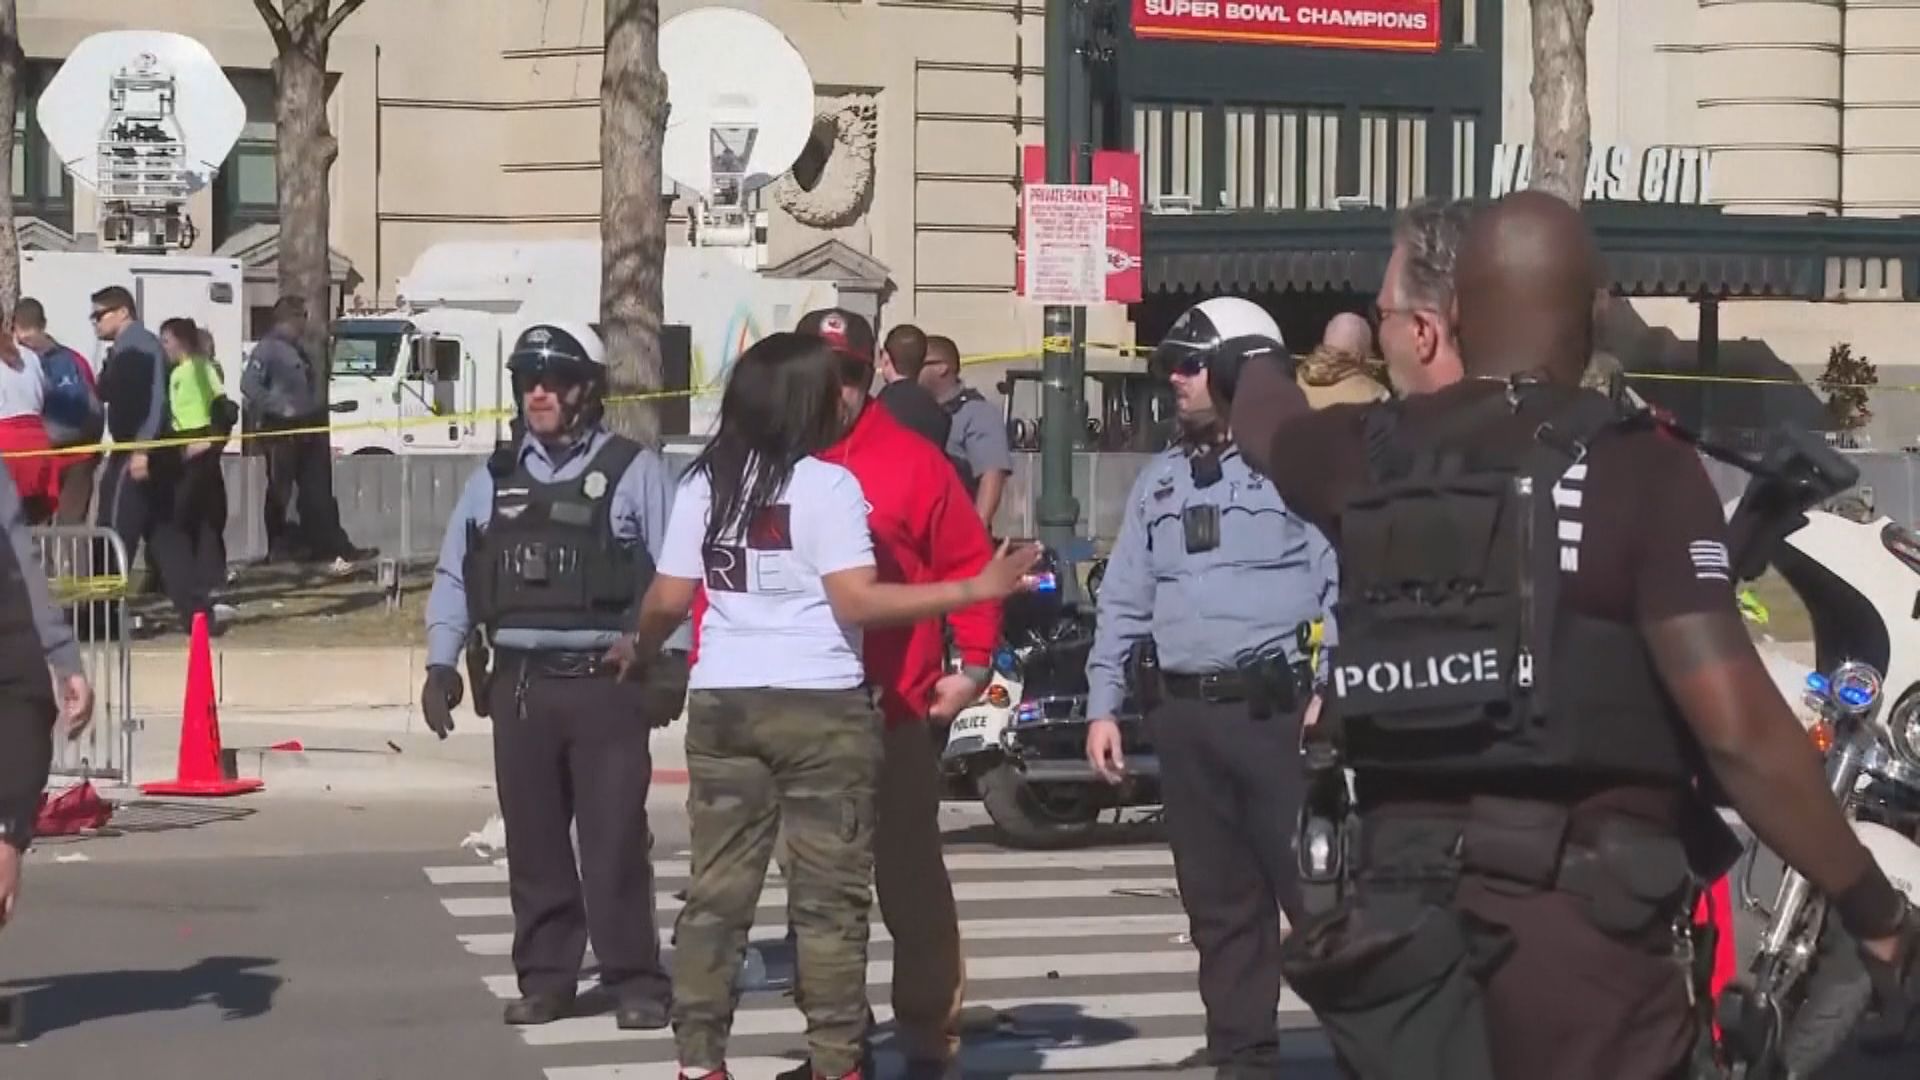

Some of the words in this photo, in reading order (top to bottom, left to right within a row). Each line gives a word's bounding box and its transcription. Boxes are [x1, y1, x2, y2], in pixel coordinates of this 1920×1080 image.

[1145, 0, 1219, 19] SUPER
[1226, 5, 1290, 22] BOWL
[1297, 8, 1427, 29] CHAMPIONS
[1334, 648, 1499, 698] POLICE
